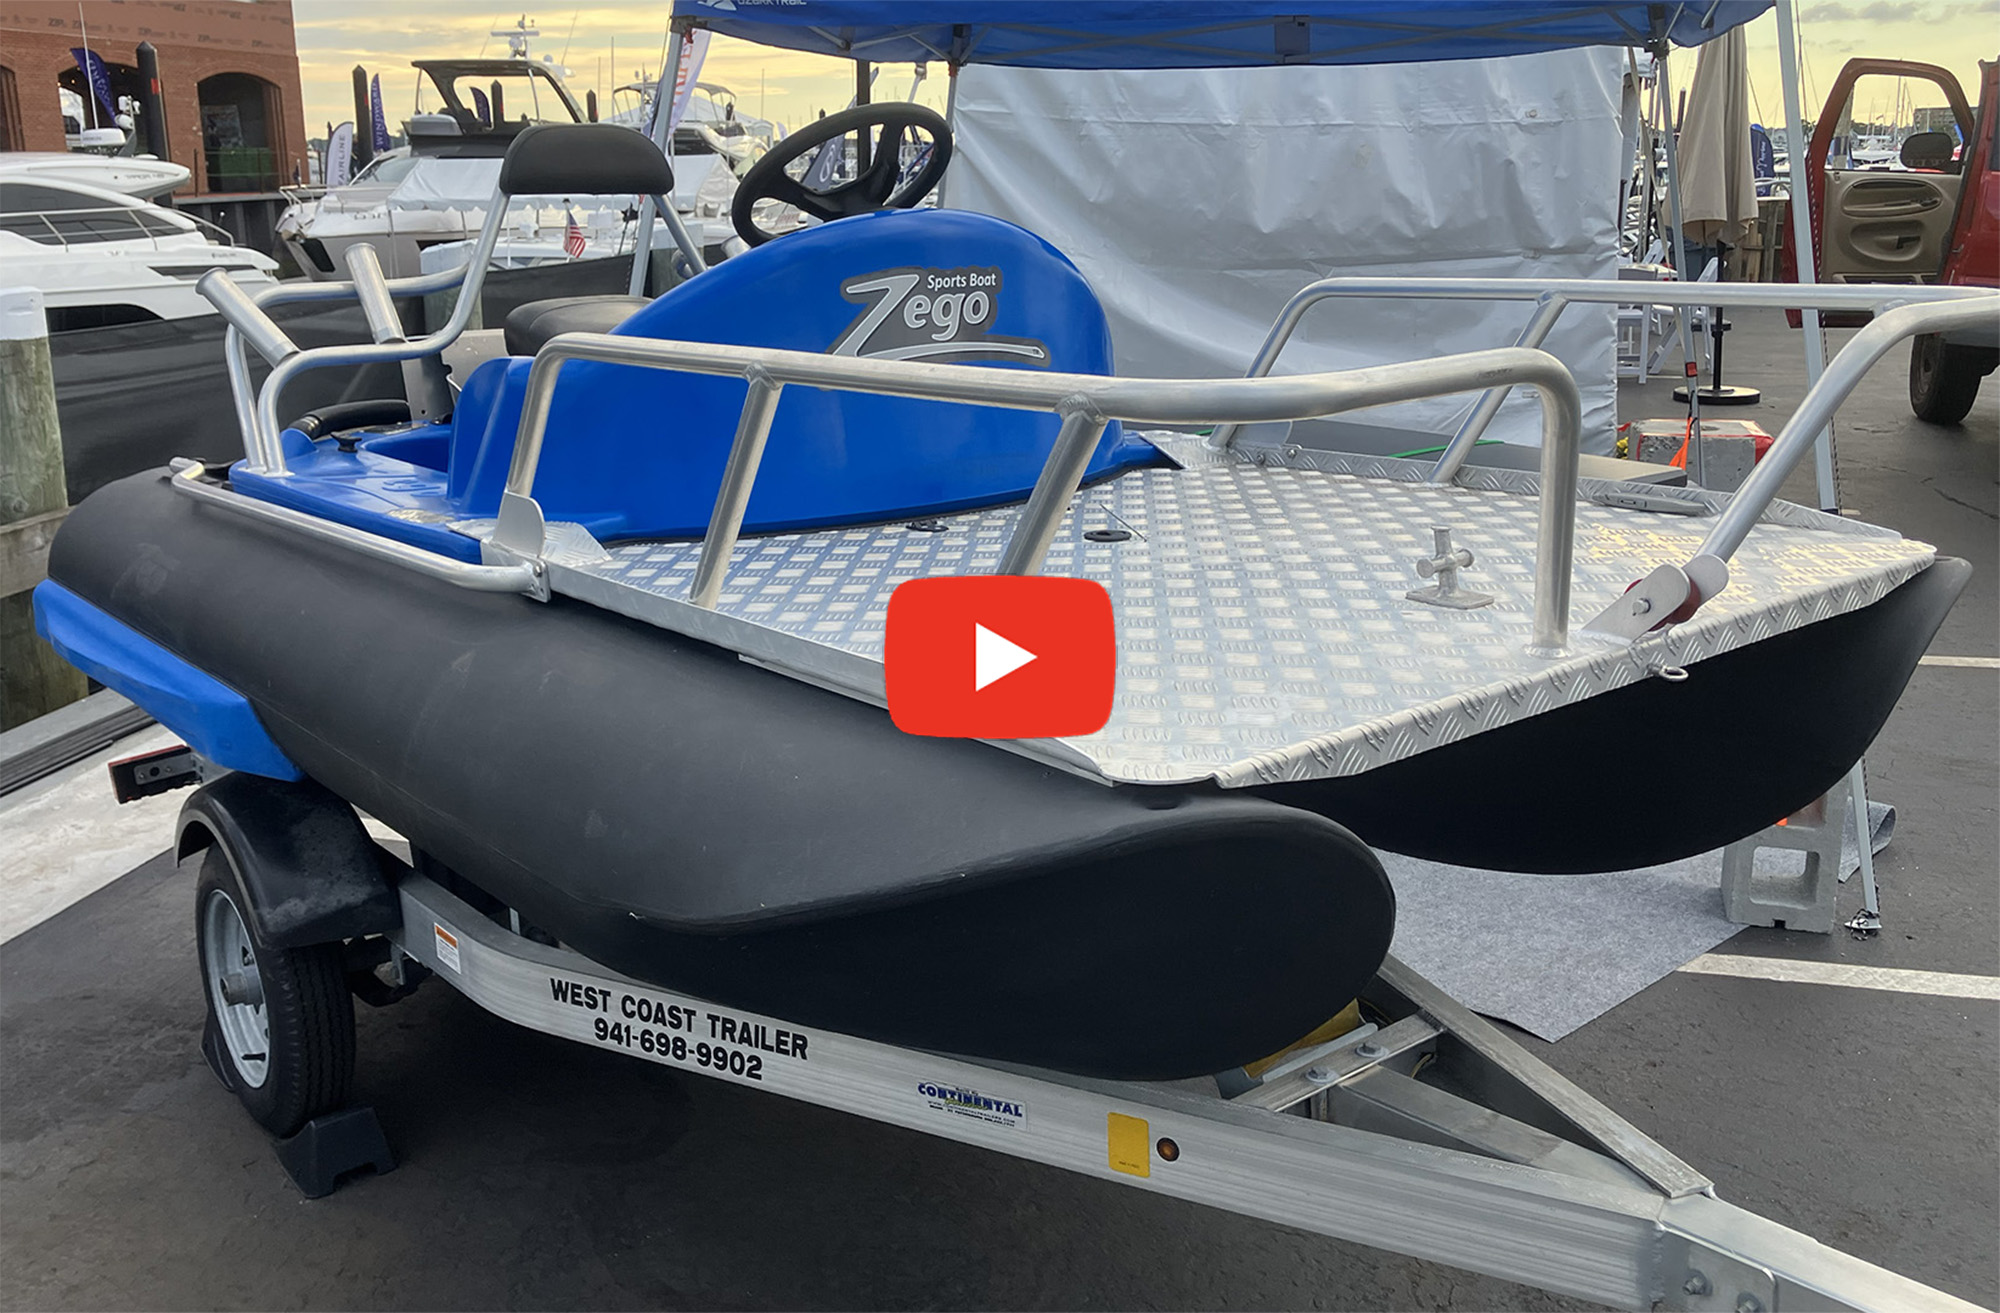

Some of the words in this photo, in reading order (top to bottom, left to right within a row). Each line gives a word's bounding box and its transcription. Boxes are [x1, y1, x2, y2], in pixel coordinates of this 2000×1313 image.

[372, 83, 384, 146] WINDWARD
[927, 274, 967, 292] Sports
[969, 272, 997, 287] Boat
[832, 273, 990, 357] Zego
[550, 977, 612, 1013] WEST
[621, 994, 697, 1033] COAST
[706, 1013, 809, 1060] TRAILER
[594, 1017, 763, 1081] 941-698-9902
[918, 1081, 1023, 1117] CONTINENTAL
